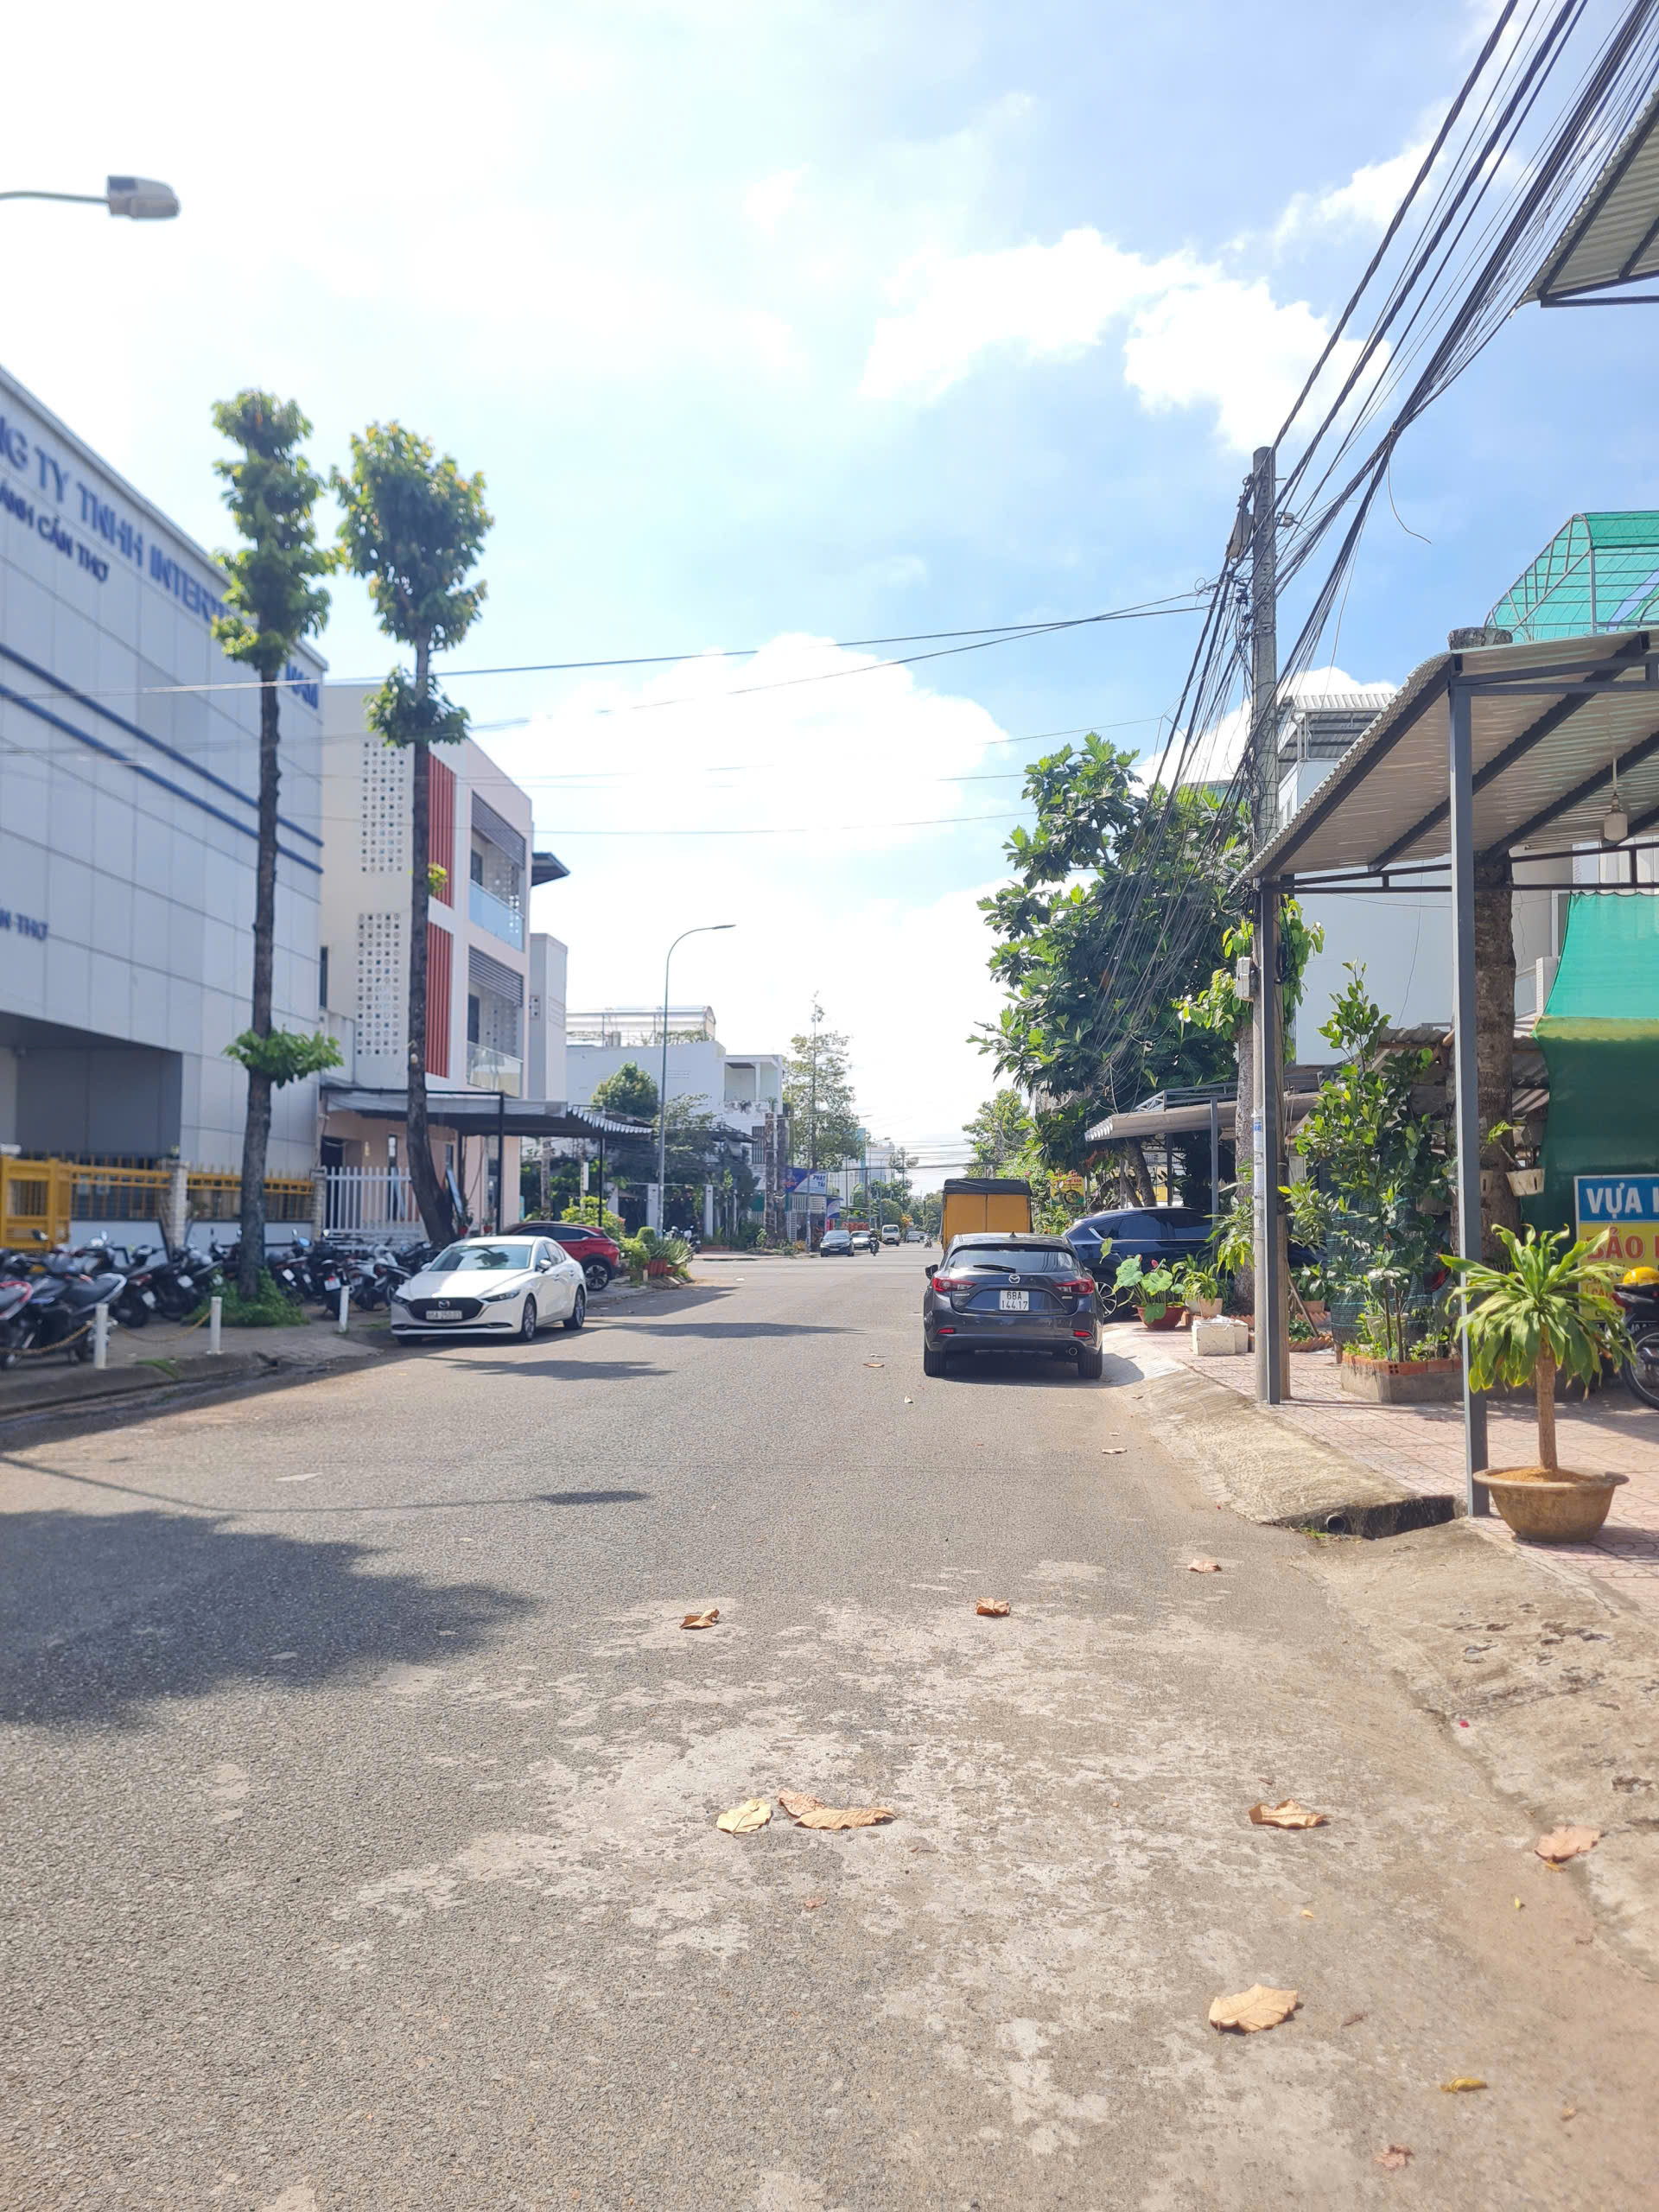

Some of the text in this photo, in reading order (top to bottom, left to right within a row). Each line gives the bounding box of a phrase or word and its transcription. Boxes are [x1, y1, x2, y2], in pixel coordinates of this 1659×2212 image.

[34, 446, 70, 503] TY
[76, 480, 143, 569] TNHH
[1586, 1182, 1643, 1219] VỰA
[1001, 1300, 1028, 1310] 144.17
[1007, 1291, 1022, 1300] 68A
